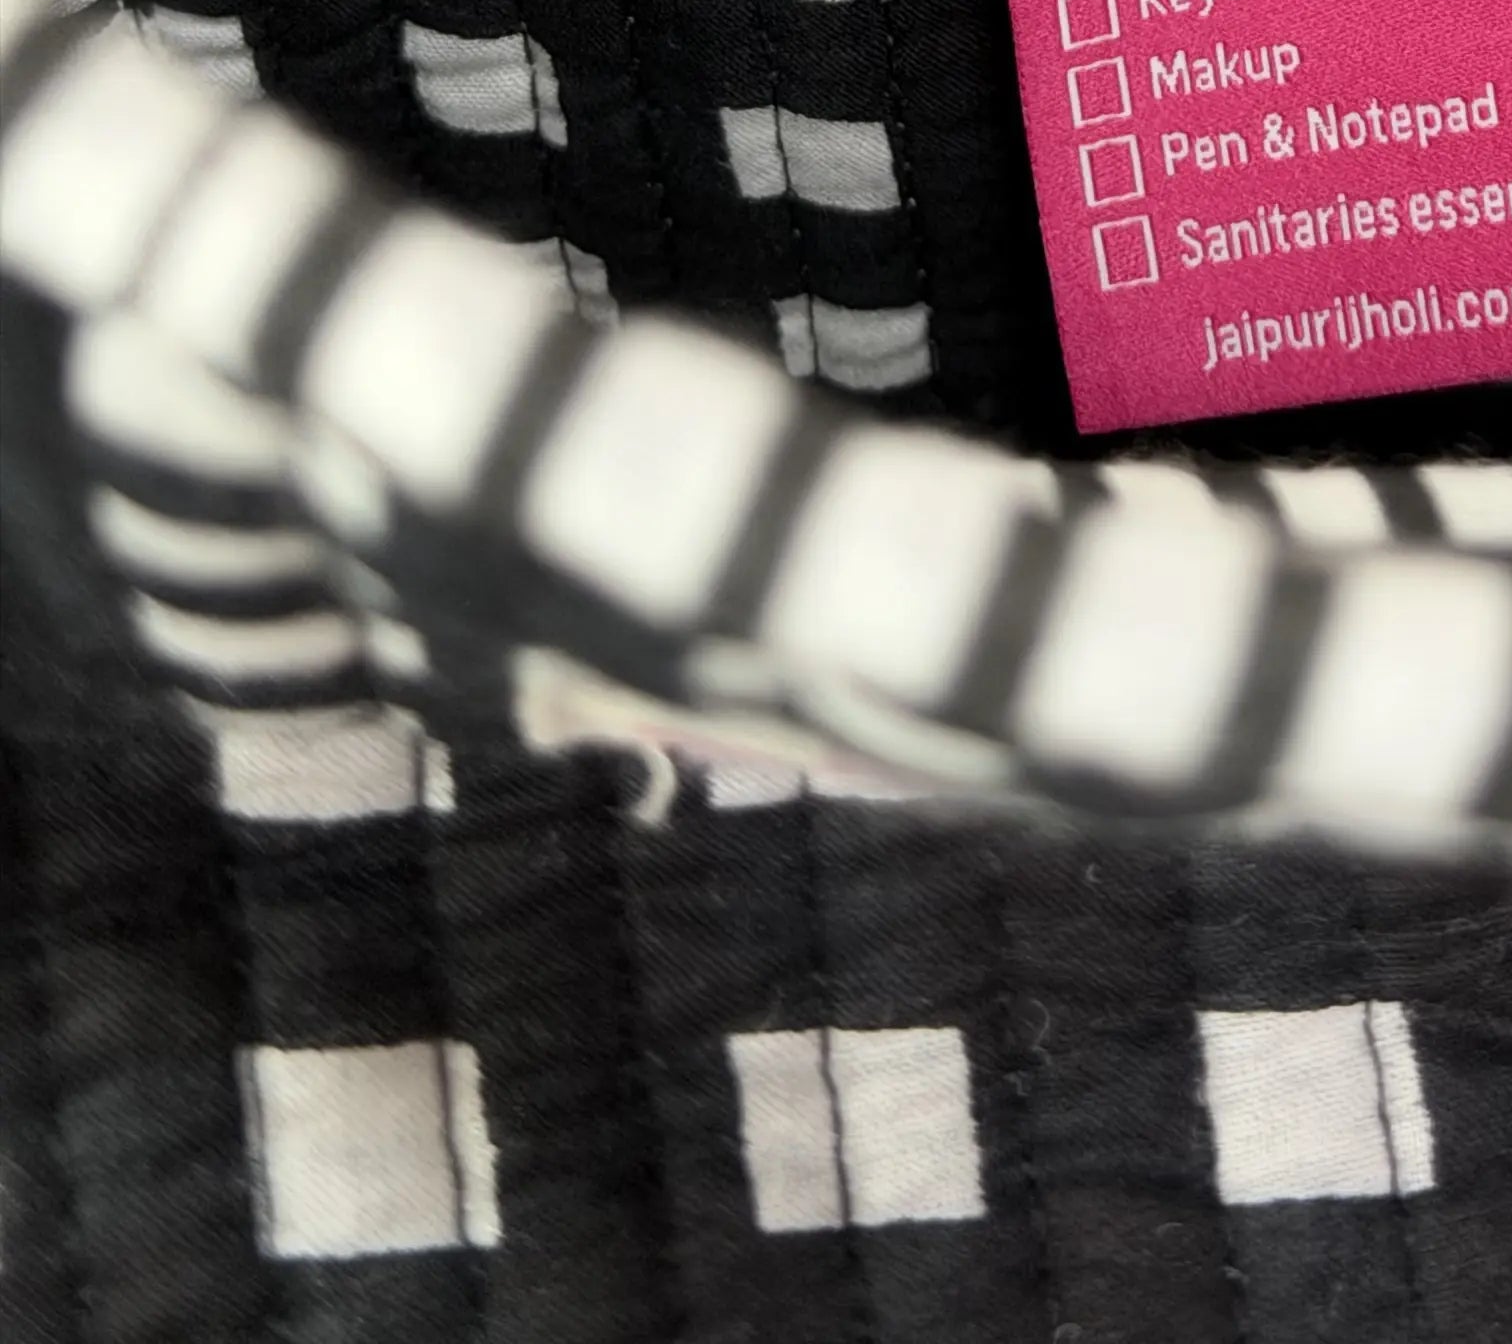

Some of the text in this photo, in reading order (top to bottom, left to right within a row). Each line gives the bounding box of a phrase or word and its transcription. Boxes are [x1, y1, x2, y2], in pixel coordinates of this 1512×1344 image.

[1149, 40, 1302, 100] Makup
[1162, 82, 1499, 176] Pen & Notepad
[1177, 193, 1397, 268] Sanitaries
